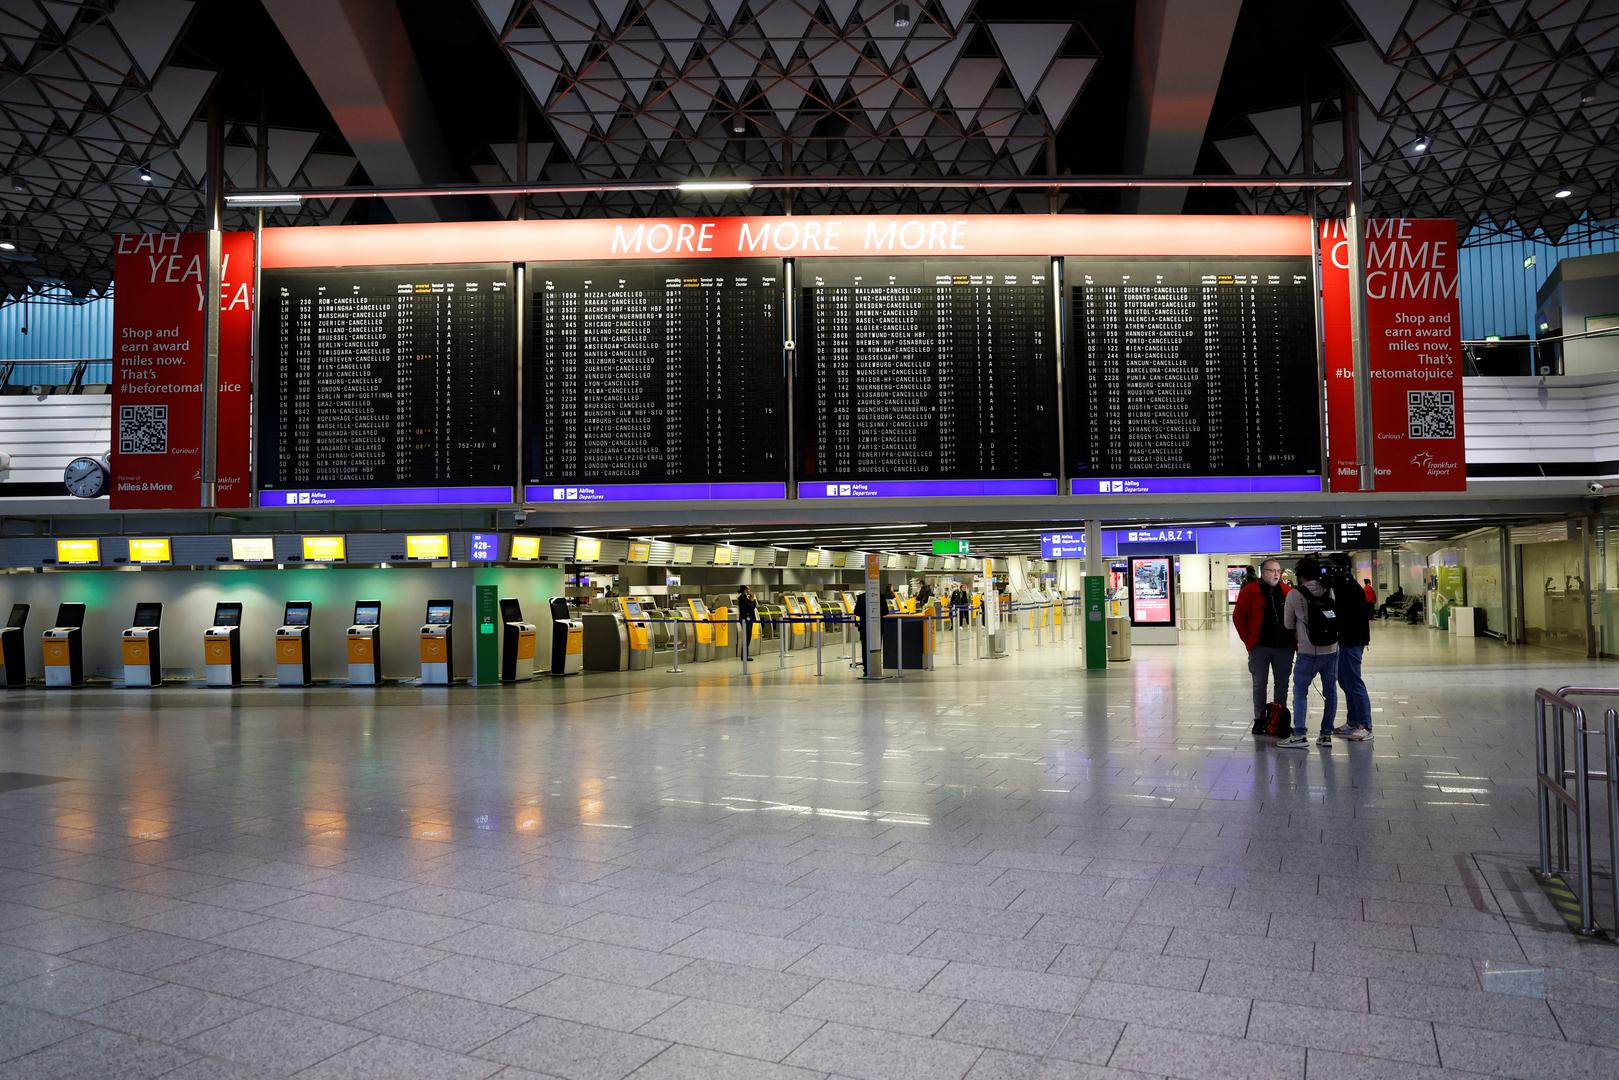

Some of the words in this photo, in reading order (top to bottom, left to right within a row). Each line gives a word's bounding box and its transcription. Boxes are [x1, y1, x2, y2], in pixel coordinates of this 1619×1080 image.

[611, 223, 715, 254] MORE
[738, 221, 841, 252] MORE
[864, 220, 968, 250] MORE
[1331, 241, 1448, 269] GMME
[1395, 312, 1425, 325] Shop
[1428, 312, 1451, 323] and
[122, 327, 152, 340] Shop
[156, 326, 179, 338] and
[1385, 328, 1412, 337] earn
[1415, 326, 1451, 337] award
[121, 344, 148, 352] earn
[152, 341, 190, 351] award
[1389, 340, 1420, 351] miles
[1423, 342, 1452, 351] now.
[121, 355, 153, 366] miles
[157, 357, 186, 365] now.
[1417, 354, 1453, 364] That's
[120, 369, 157, 380] That's
[1335, 368, 1454, 381] #bretomatojuice
[120, 382, 241, 394] #beforetomatuice
[1377, 432, 1405, 440] Curious?
[1426, 468, 1450, 476] Airport
[118, 483, 141, 491] Miles
[141, 483, 149, 491] &
[150, 483, 173, 491] More
[473, 551, 487, 559] 499
